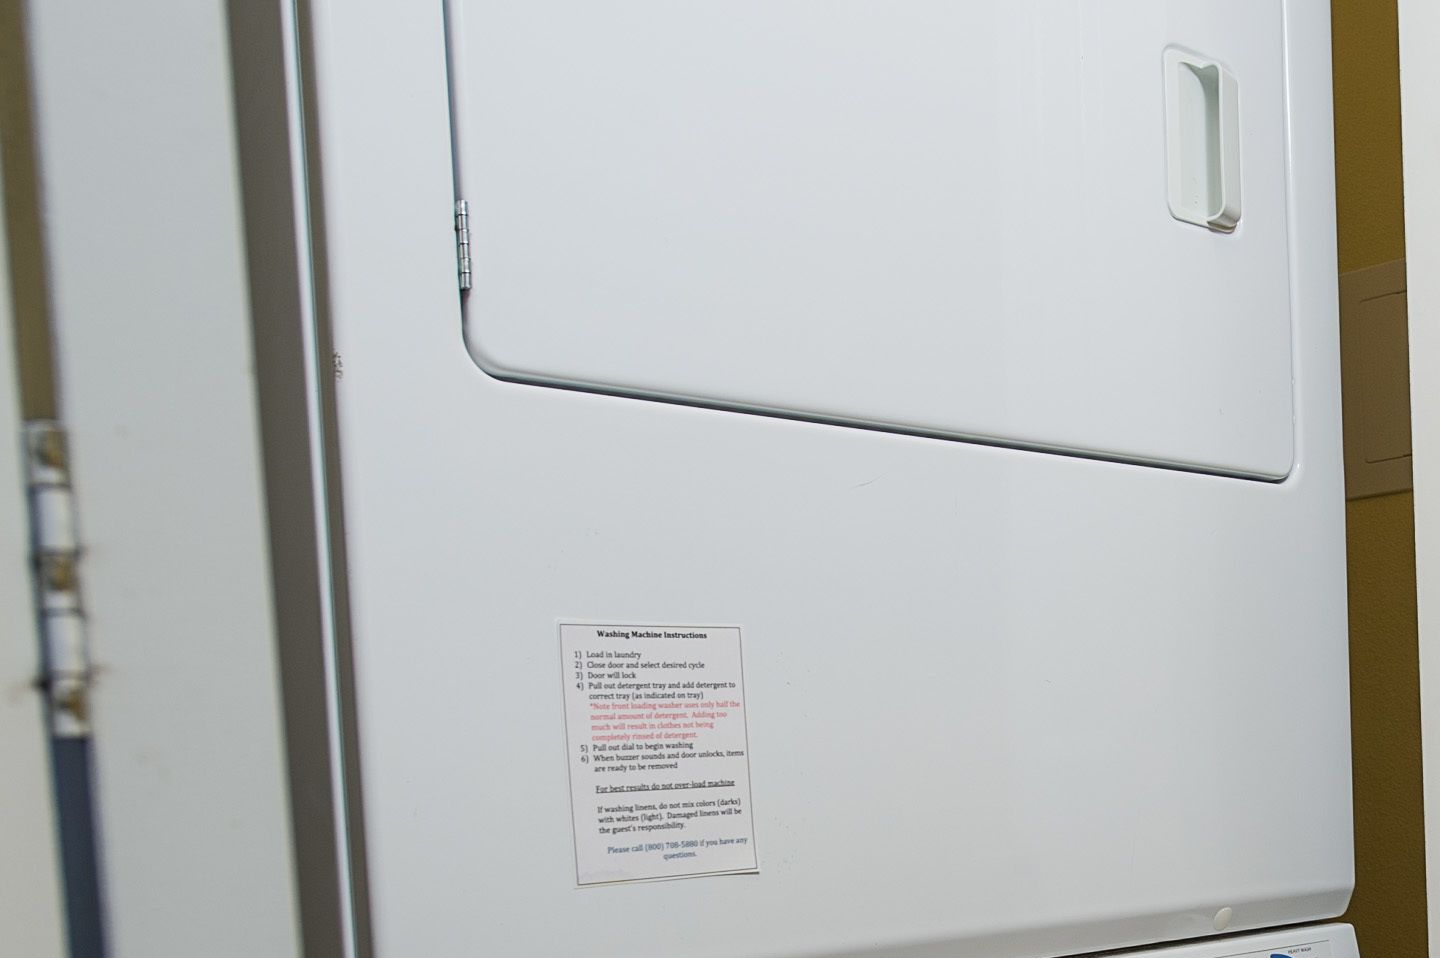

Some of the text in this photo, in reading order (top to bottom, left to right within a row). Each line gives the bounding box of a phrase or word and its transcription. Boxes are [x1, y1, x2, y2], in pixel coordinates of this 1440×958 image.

[597, 630, 708, 640] Washing Machine Instructions
[574, 651, 582, 659] 1)
[614, 651, 642, 660] laundry
[575, 661, 582, 670] 2)
[688, 662, 705, 670] cycle
[576, 672, 584, 680] 3)
[576, 682, 584, 691] 4)
[617, 682, 651, 690] detergent
[652, 682, 666, 690] tray
[696, 682, 728, 690] detergent
[632, 692, 642, 701] (as
[687, 692, 704, 700] tray)
[580, 744, 588, 754] 5)
[645, 742, 664, 751] begin
[581, 755, 590, 764] 6)
[608, 764, 627, 773] ready
[596, 785, 608, 794] For
[610, 784, 624, 792] best
[626, 784, 650, 792] results
[718, 798, 741, 807] (darks)
[667, 811, 698, 819] Damaged
[632, 844, 644, 852] call
